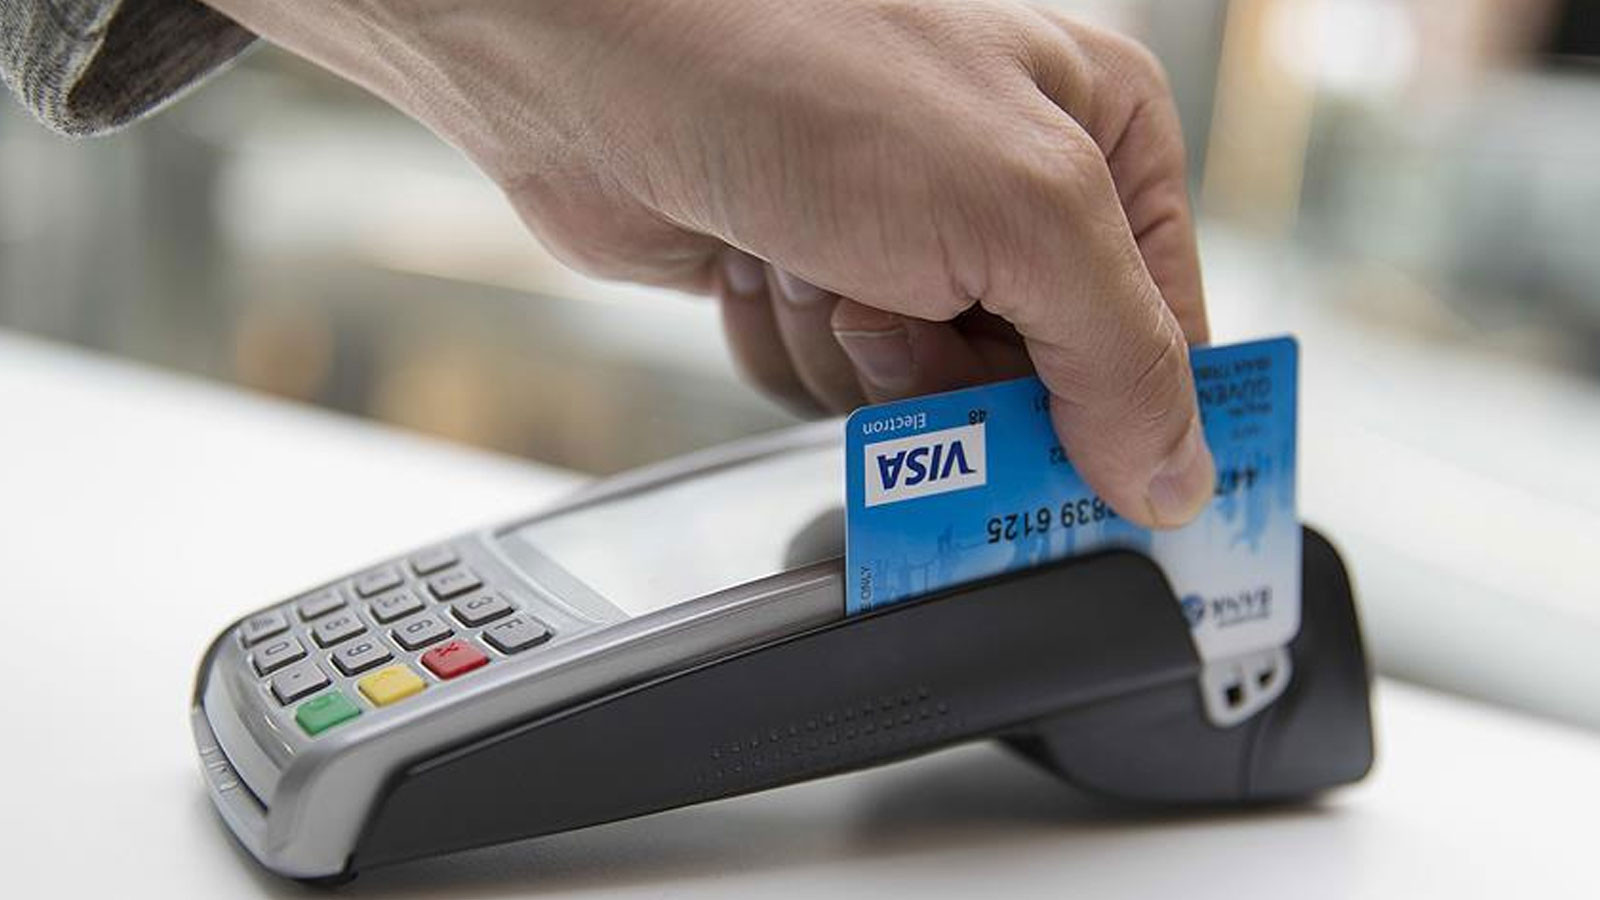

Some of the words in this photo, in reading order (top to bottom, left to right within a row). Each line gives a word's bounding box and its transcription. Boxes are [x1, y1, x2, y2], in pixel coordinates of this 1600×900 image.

[863, 412, 926, 434] Electron
[969, 409, 986, 424] 48
[877, 440, 976, 490] VISA
[988, 508, 1051, 544] 6125
[406, 619, 433, 634] 6
[347, 643, 372, 657] 9
